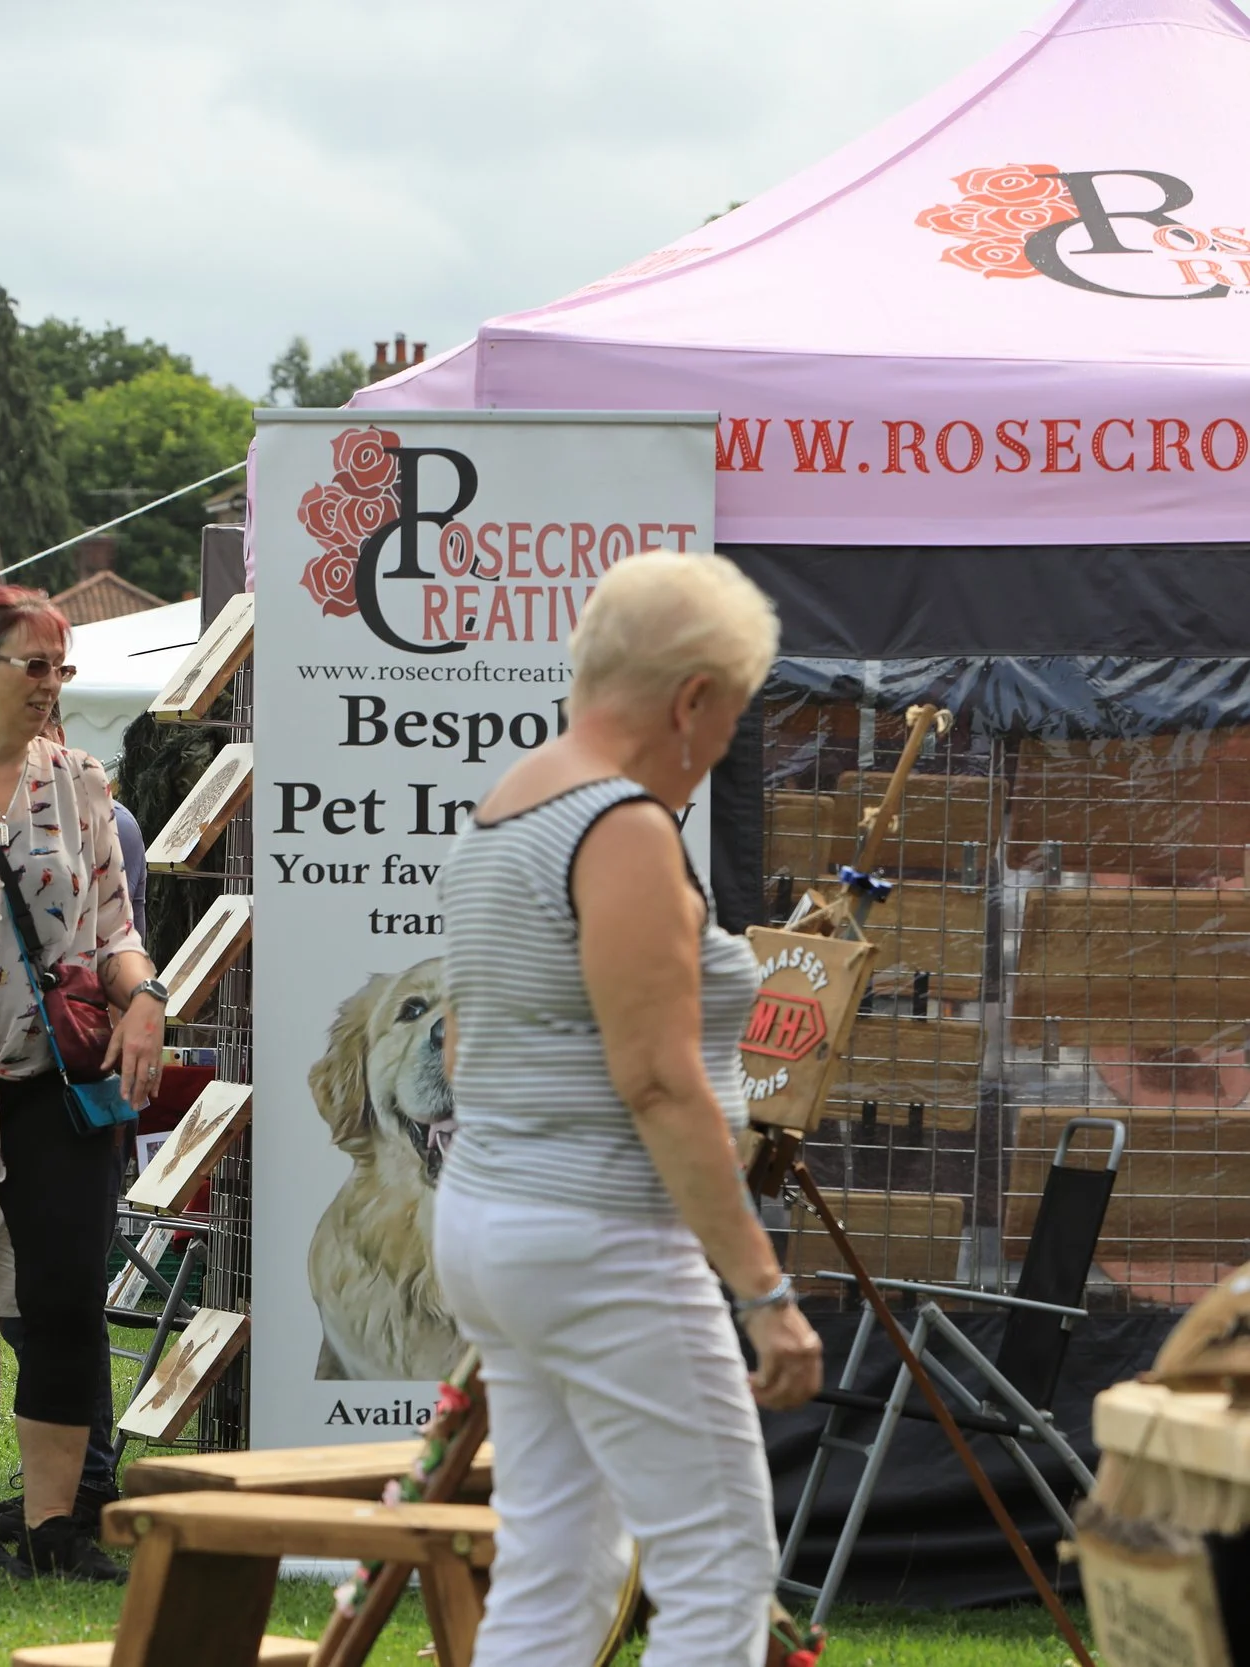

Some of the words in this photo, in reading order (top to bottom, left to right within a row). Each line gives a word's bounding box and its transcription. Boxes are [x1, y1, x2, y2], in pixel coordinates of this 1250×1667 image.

[272, 782, 387, 835] Pet
[270, 853, 370, 885] Your
[381, 853, 441, 886] fav
[758, 946, 829, 991] MASSEY
[324, 1399, 440, 1426] Availa
